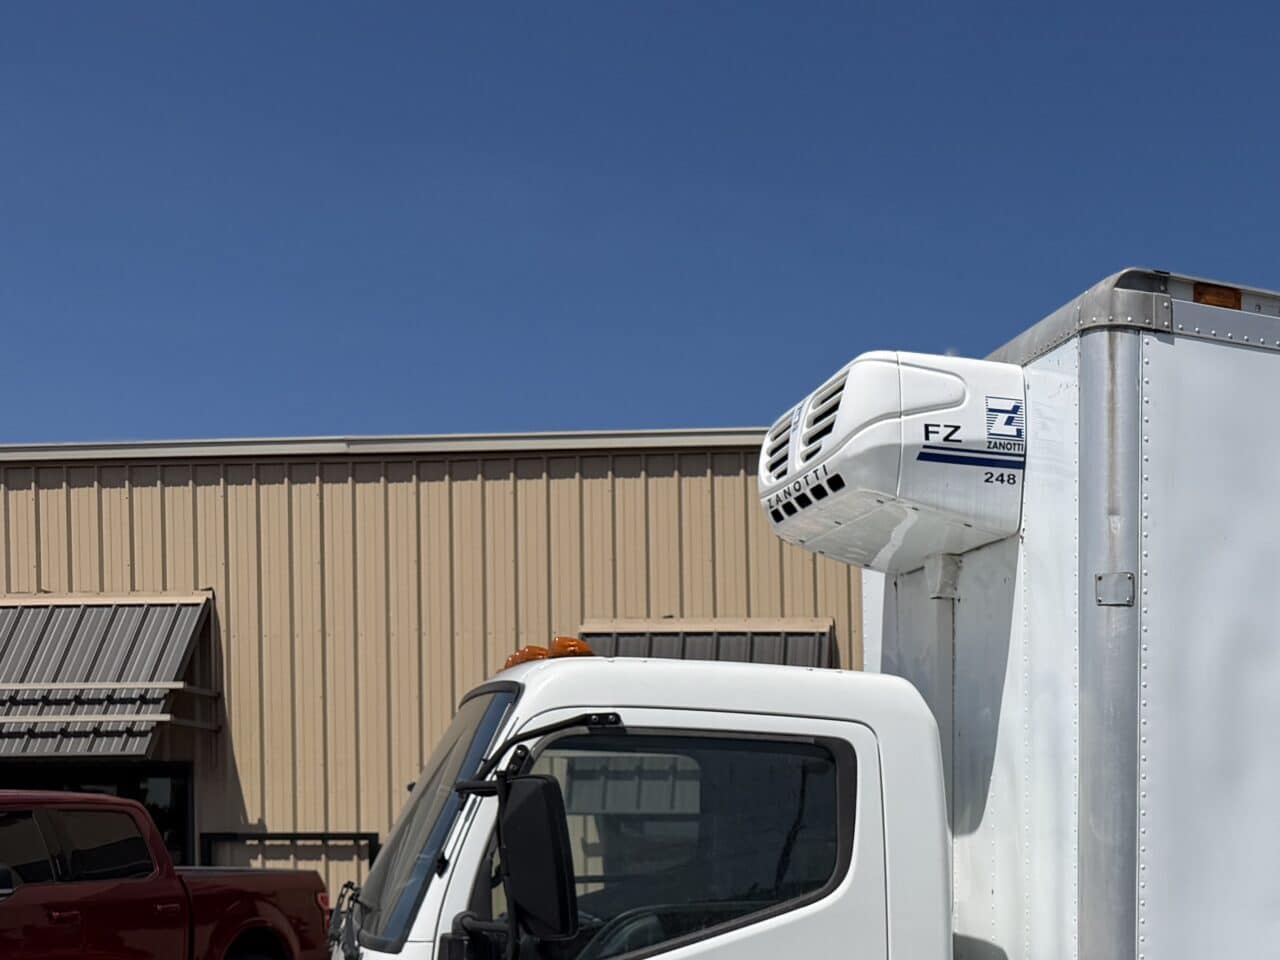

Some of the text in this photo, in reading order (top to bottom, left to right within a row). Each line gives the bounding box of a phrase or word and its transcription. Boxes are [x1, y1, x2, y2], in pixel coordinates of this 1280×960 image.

[924, 424, 962, 443] FZ
[987, 440, 1024, 452] ZANOTTI
[984, 472, 1017, 485] 248
[767, 464, 829, 510] ZANOTTI
